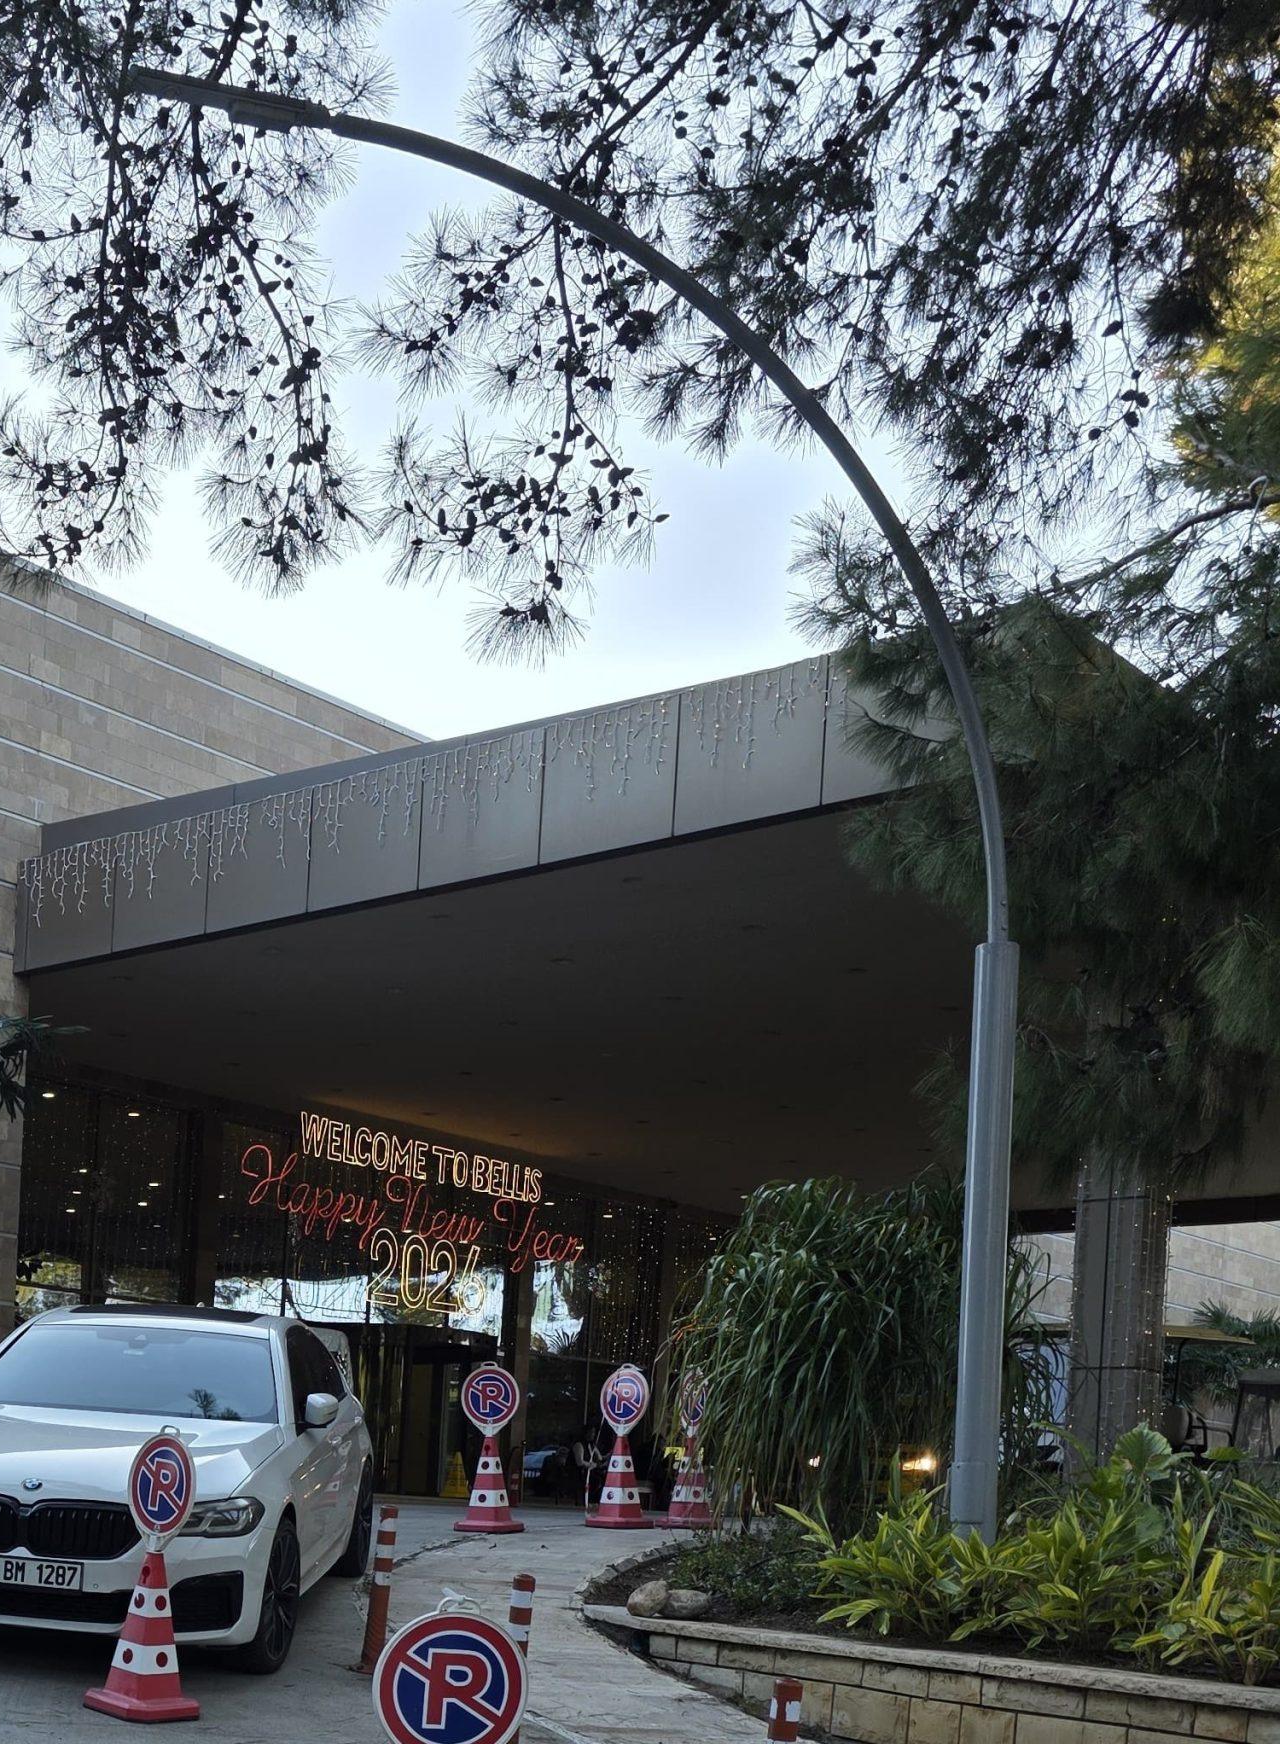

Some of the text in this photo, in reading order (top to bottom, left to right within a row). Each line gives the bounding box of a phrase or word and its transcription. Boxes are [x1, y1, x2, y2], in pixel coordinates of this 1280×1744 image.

[300, 1111, 429, 1180] WELCOME
[432, 1145, 468, 1188] TO
[240, 1144, 584, 1273] Happy New Year
[366, 1227, 486, 1318] 2026
[3, 1560, 26, 1583] BM
[36, 1563, 78, 1587] 1287
